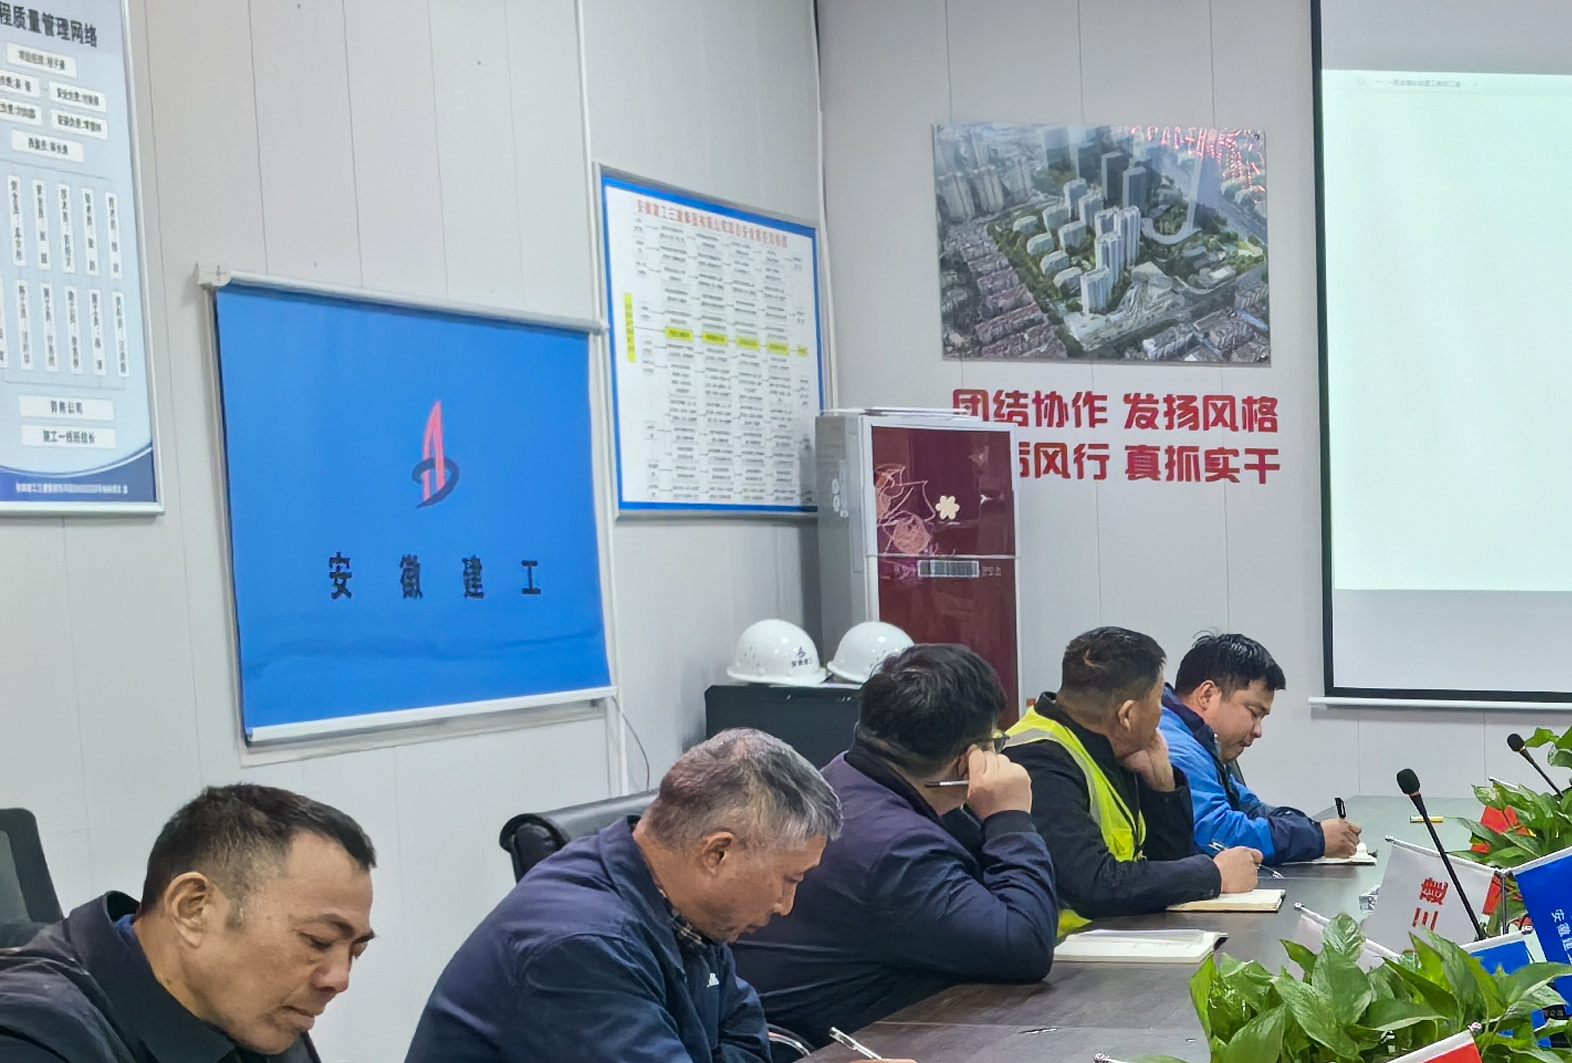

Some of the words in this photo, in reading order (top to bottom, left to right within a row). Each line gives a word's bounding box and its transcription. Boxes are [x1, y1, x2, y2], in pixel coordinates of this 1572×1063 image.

[952, 388, 1108, 428] 团结协作
[1123, 392, 1280, 433] 发扬风格
[1124, 444, 1281, 485] 真抓实干
[328, 551, 542, 600] 安徽建工
